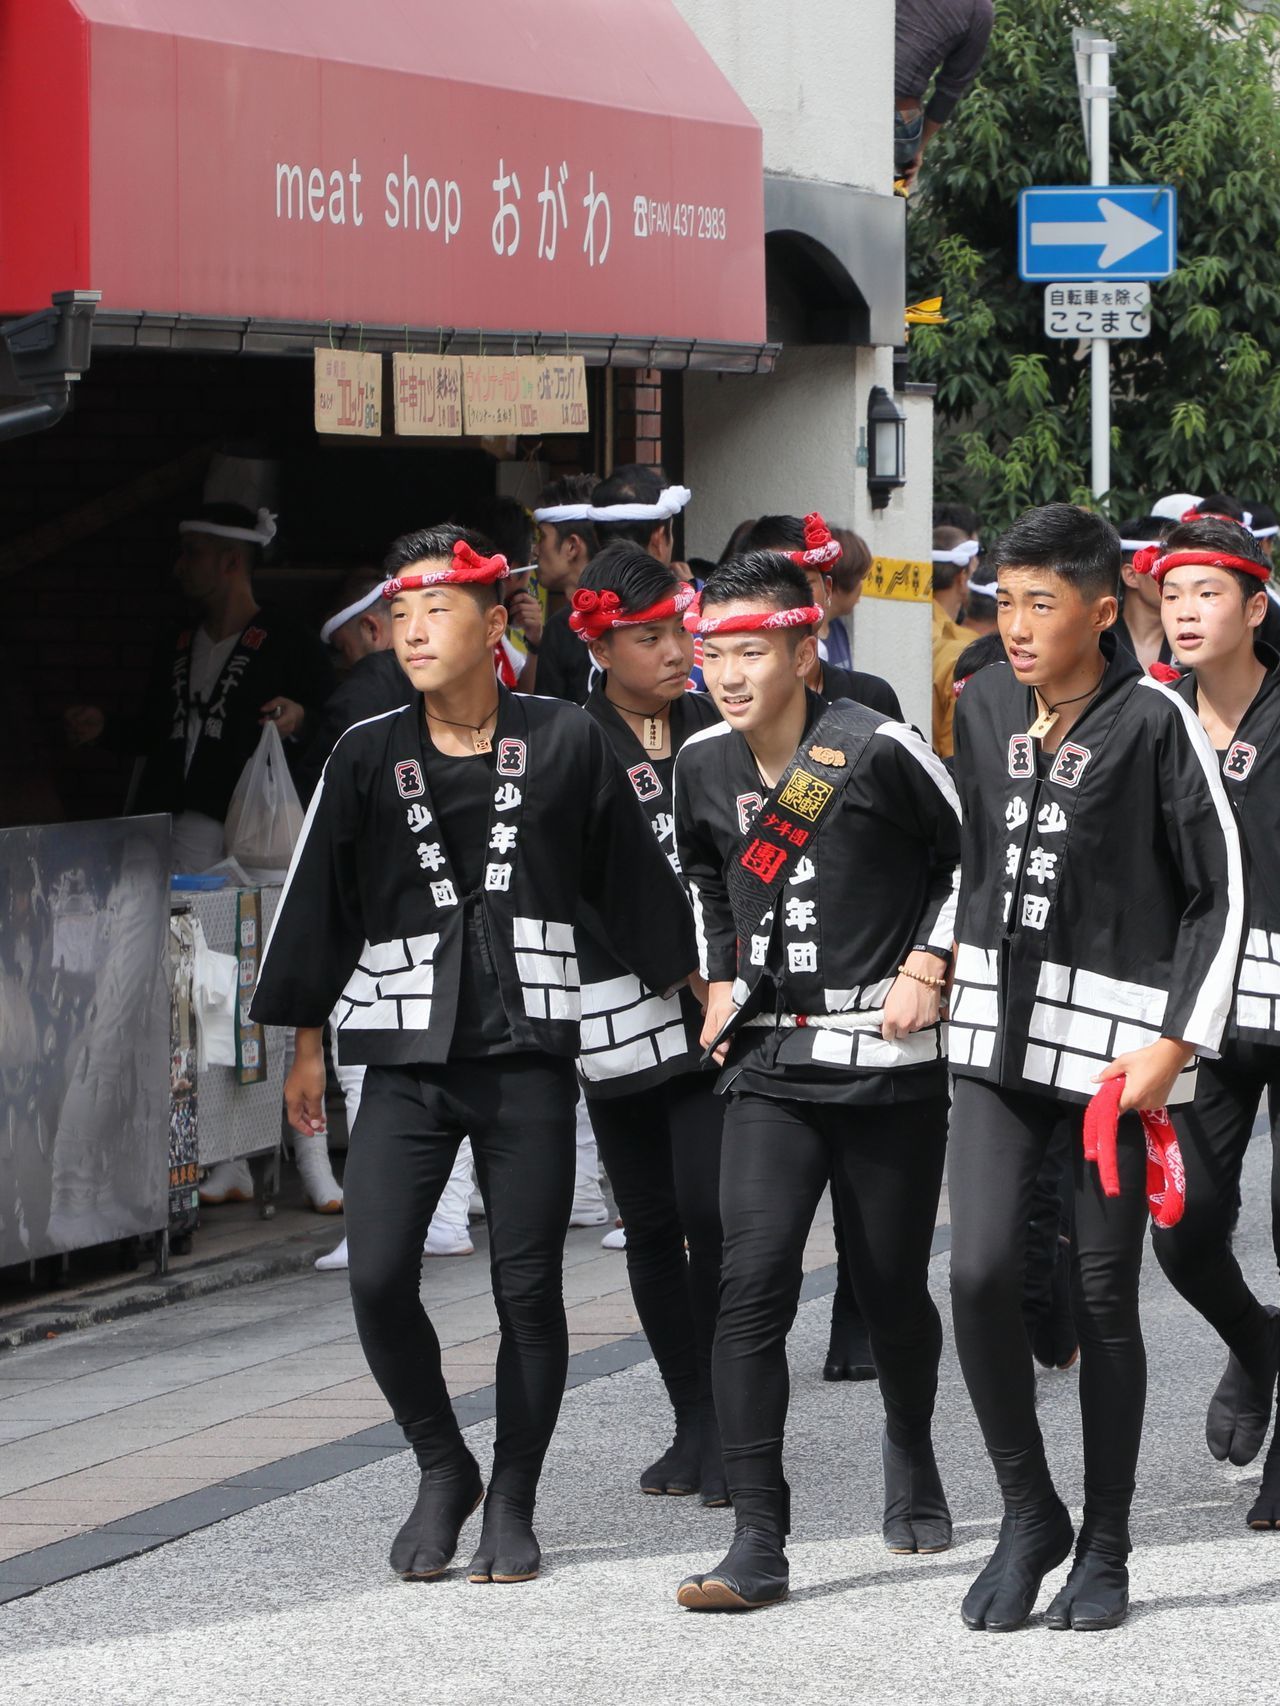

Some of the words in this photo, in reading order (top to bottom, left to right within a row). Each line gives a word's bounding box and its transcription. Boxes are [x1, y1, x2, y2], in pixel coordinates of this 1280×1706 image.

[276, 158, 363, 226] meat
[385, 154, 461, 243] shop
[492, 158, 610, 266] おがわ
[673, 205, 694, 237] 437
[697, 205, 726, 240] 2983
[1050, 288, 1144, 306] 自転車を除く
[1050, 310, 1147, 333] ここまで
[407, 803, 458, 908] 少年団
[484, 782, 522, 891] 少年団
[1021, 802, 1067, 930] 少年団
